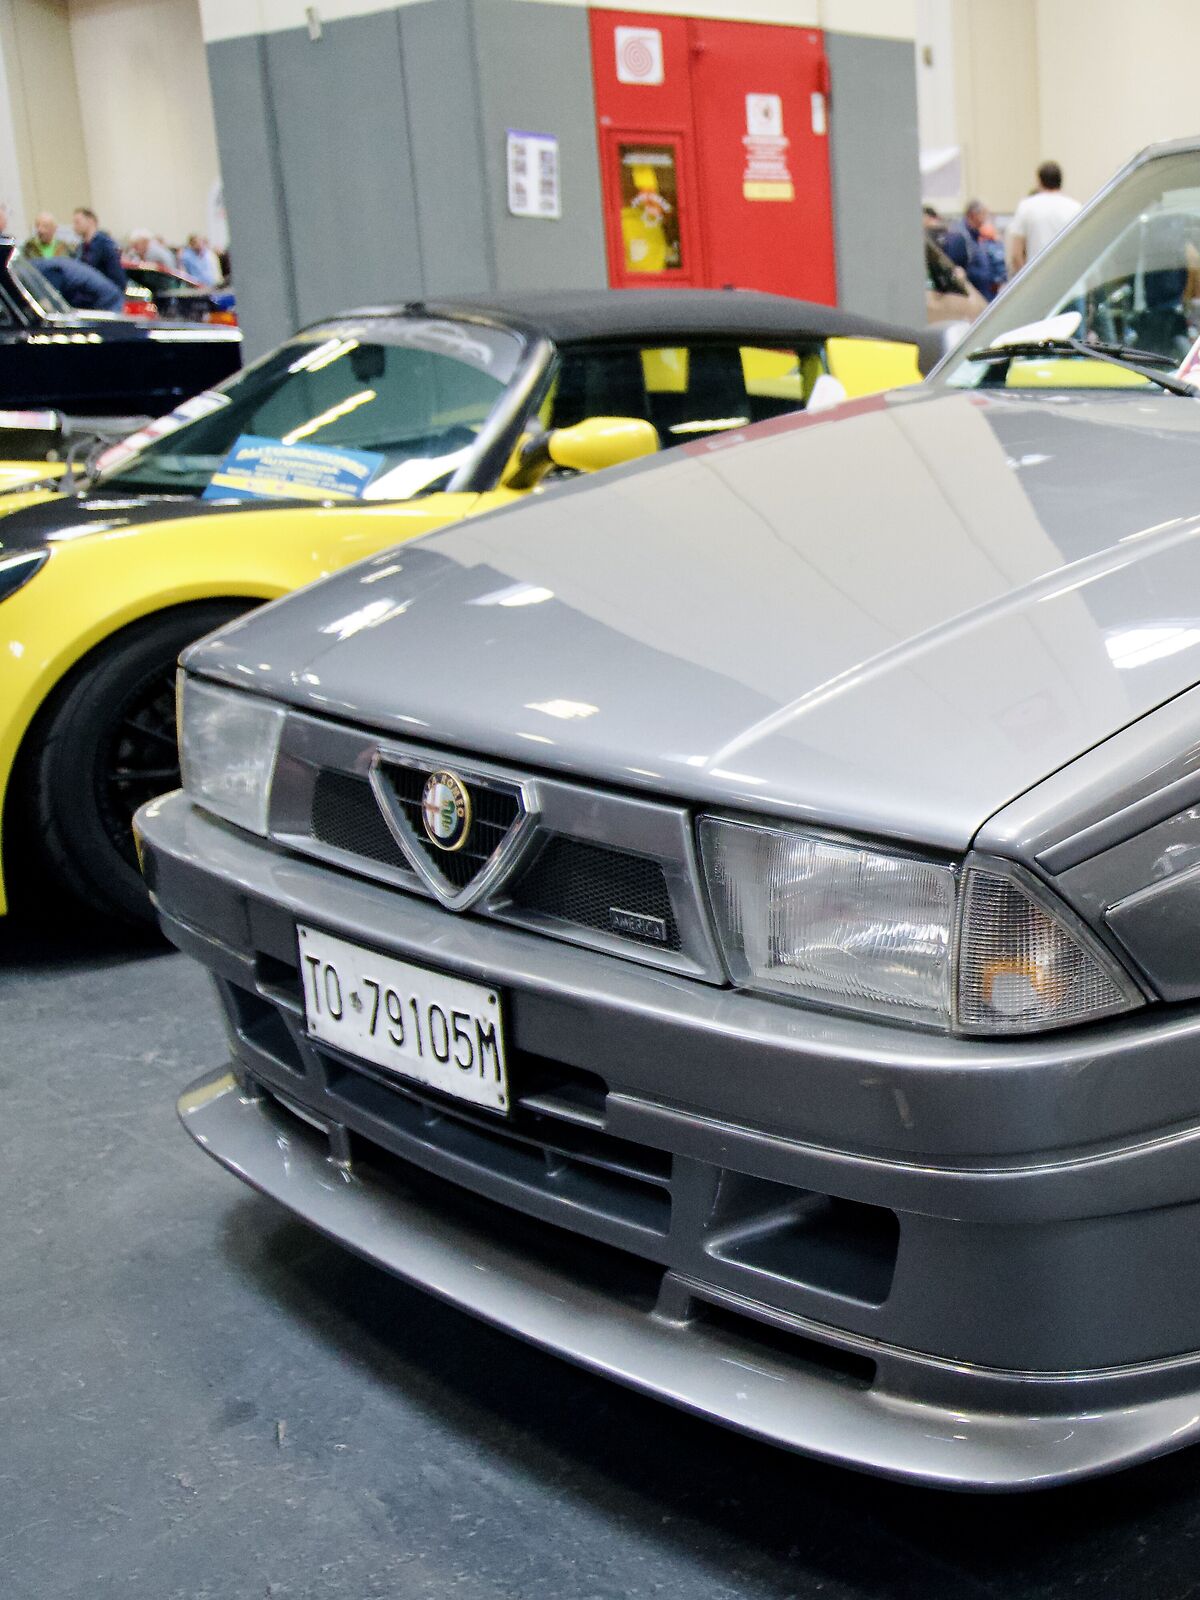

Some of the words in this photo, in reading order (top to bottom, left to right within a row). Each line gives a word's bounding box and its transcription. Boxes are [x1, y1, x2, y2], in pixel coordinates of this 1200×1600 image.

[440, 774, 465, 818] ROMEO
[612, 915, 662, 937] AMERICA
[305, 955, 343, 1021] TO
[362, 977, 502, 1083] 79105M
